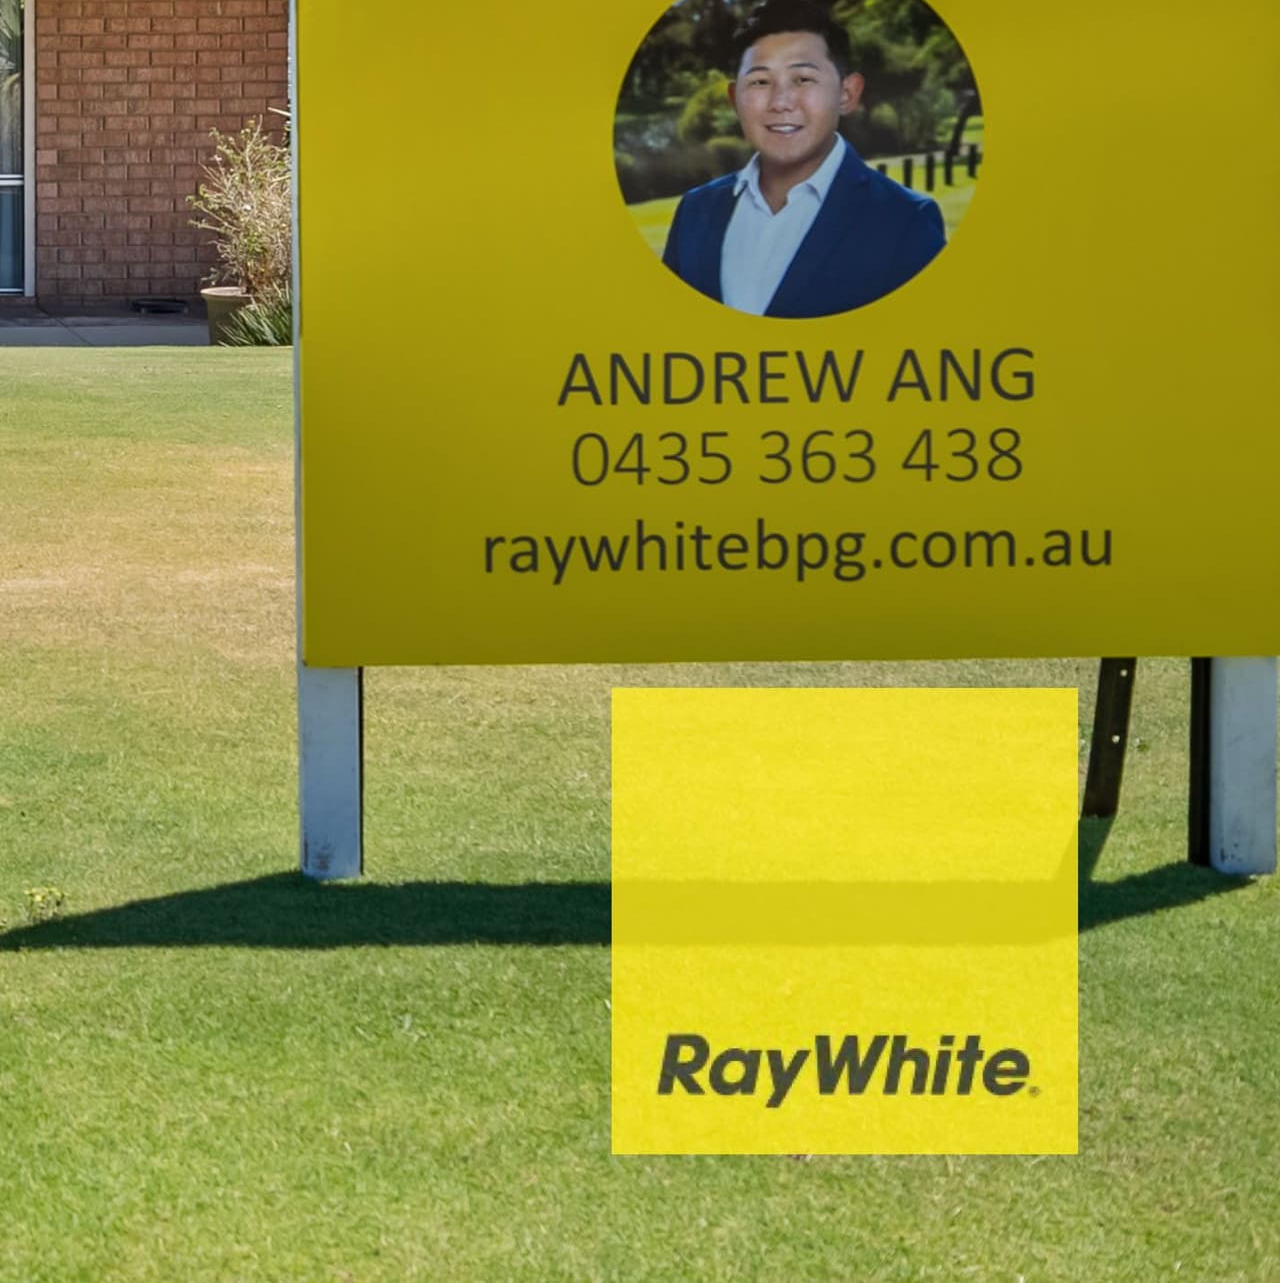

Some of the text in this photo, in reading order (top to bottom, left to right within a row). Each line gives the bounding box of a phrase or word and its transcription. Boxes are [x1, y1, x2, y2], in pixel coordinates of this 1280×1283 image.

[557, 347, 1037, 407] ANDREW ANG
[571, 427, 1024, 487] 0435 363 438
[484, 517, 1114, 586] raywhitebpg.com.au
